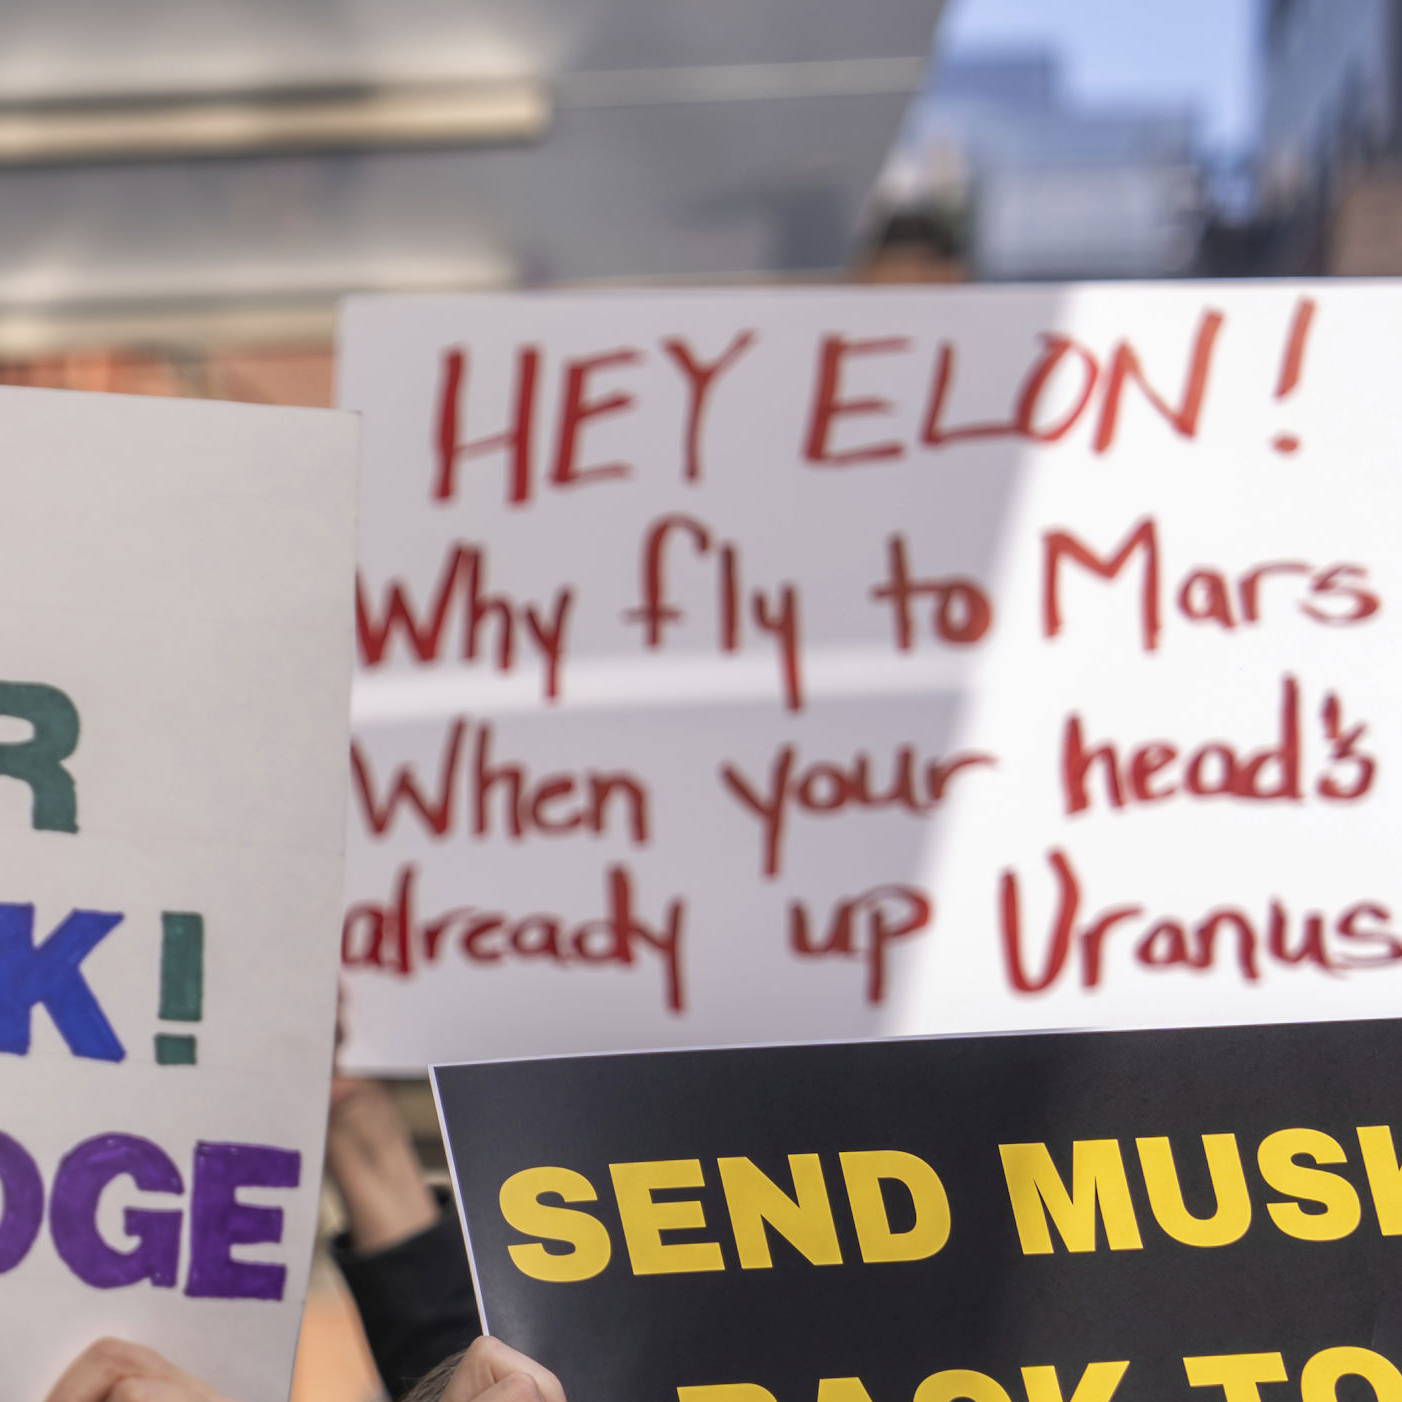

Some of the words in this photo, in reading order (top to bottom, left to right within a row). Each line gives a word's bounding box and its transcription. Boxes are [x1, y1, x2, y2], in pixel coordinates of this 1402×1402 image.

[432, 326, 760, 506] HEY
[807, 297, 1314, 462] ELON!
[356, 548, 569, 699] Why
[626, 515, 806, 712] fly
[872, 544, 992, 648] to
[1044, 520, 1379, 651] Mars
[353, 732, 647, 842] When
[727, 752, 998, 875] your
[1062, 678, 1375, 814] head's
[342, 869, 682, 1011] already
[793, 893, 931, 1002] up
[1001, 851, 1402, 994] Uranus
[499, 1151, 950, 1282] SEND
